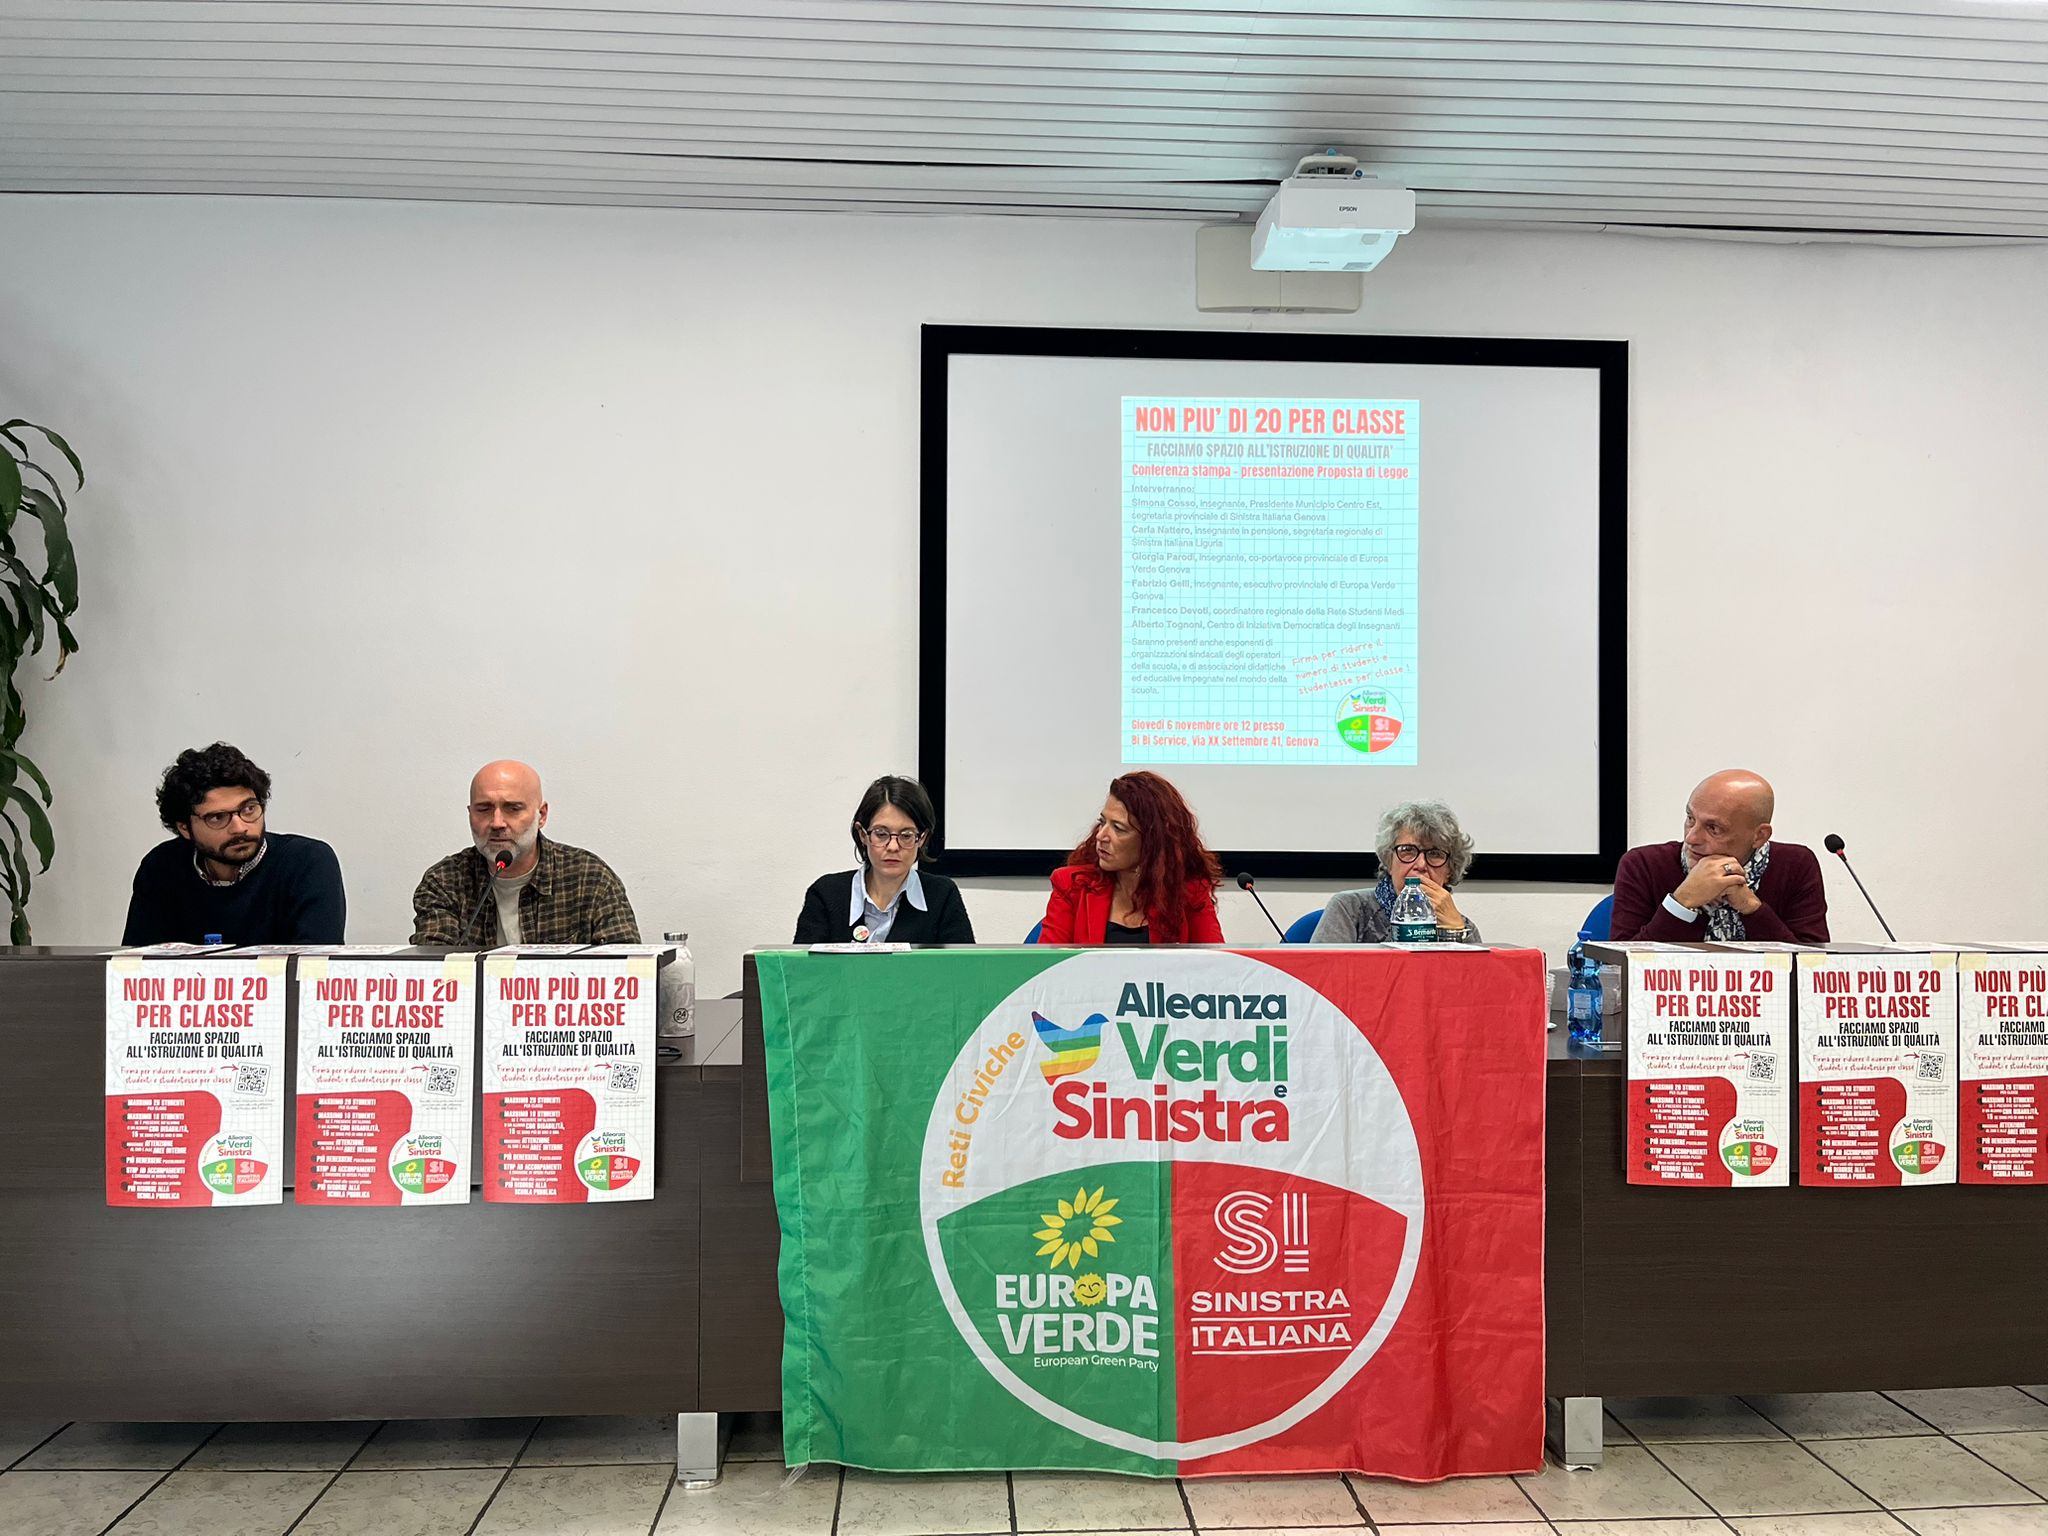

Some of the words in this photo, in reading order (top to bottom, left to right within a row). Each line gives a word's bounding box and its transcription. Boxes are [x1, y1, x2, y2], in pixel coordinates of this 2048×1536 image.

[1136, 407, 1176, 432] NON
[1228, 409, 1248, 432] DI
[1255, 408, 1282, 433] 20
[1289, 409, 1325, 434] PER
[1332, 409, 1405, 435] CLASSE
[1147, 443, 1204, 457] FACCIAMO
[1206, 443, 1244, 458] SPAZIO
[1247, 443, 1330, 458] ALL'ISTRUZIONE
[1333, 444, 1344, 458] DI
[1132, 464, 1190, 476] Conferenza
[1192, 465, 1231, 478] stampa
[1241, 466, 1314, 478] presentazione
[1317, 466, 1363, 479] Proposta
[1366, 466, 1375, 478] di
[1378, 466, 1409, 480] Legge
[1132, 484, 1195, 493] Interverranno:
[1167, 720, 1173, 730] 6
[1175, 720, 1221, 731] novembre
[1223, 722, 1239, 731] ore
[1241, 720, 1251, 731] 12
[1253, 722, 1285, 732] presso
[1208, 736, 1219, 746] XX
[1222, 736, 1268, 746] Settembre
[1286, 737, 1319, 747] Genova
[123, 977, 165, 1001] NON
[173, 972, 206, 1001] PIÙ
[214, 977, 234, 1001] DI
[242, 977, 268, 1001] 20
[316, 977, 357, 1001] NON
[365, 972, 398, 1002] PIÙ
[405, 979, 424, 1002] DI
[432, 978, 458, 1002] 20
[499, 977, 540, 1000] NON
[548, 971, 579, 1000] PIÙ
[587, 977, 606, 999] DI
[614, 976, 639, 1000] 20
[1644, 969, 1681, 992] NON
[1689, 964, 1718, 992] PIÙ
[1725, 970, 1743, 992] DI
[1750, 970, 1773, 993] 20
[1813, 971, 1850, 994] NON
[1858, 966, 1887, 993] PIÙ
[1894, 971, 1911, 993] DI
[1918, 970, 1941, 993] 20
[1975, 970, 2011, 992] NON
[2019, 965, 2046, 992] PIÙ
[1115, 981, 1287, 1020] Alleanza
[1656, 995, 1689, 1016] PER
[1696, 995, 1761, 1017] CLASSE
[1825, 996, 1859, 1018] PER
[1865, 996, 1931, 1018] CLASSE
[1987, 995, 2019, 1017] PER
[136, 1004, 172, 1028] PER
[179, 1004, 254, 1028] CLASSE
[328, 1005, 364, 1028] PER
[371, 1005, 444, 1028] CLASSE
[511, 1003, 547, 1027] PER
[554, 1003, 626, 1027] CLASSE
[150, 1032, 201, 1045] FACCIAMO
[204, 1031, 240, 1044] SPAZIO
[525, 1030, 575, 1043] FACCIAMO
[578, 1030, 612, 1043] SPAZIO
[1669, 1021, 1716, 1033] FACCIAMO
[1719, 1021, 1750, 1033] SPAZIO
[1839, 1022, 1886, 1034] FACCIAMO
[1888, 1022, 1919, 1033] SPAZIO
[2000, 1021, 2045, 1033] FACCIAMO
[341, 1032, 392, 1045] FACCIAMO
[395, 1032, 430, 1045] SPAZIO
[502, 1043, 577, 1056] ALL'ISTRUZIONE
[581, 1044, 592, 1056] DI
[595, 1040, 636, 1057] QUALITÀ
[1647, 1033, 1720, 1046] ALL'ISTRUZIONE
[1722, 1034, 1732, 1046] DI
[1734, 1031, 1771, 1047] QUALITÀ
[1818, 1035, 1889, 1047] ALL'ISTRUZIONE
[1892, 1035, 1901, 1047] DI
[1904, 1031, 1940, 1048] QUALITÀ
[126, 1045, 204, 1059] ALL'ISTRUZIONE
[207, 1045, 218, 1058] DI
[221, 1042, 263, 1060] QUALITÀ
[318, 1045, 395, 1058] ALL'ISTRUZIONE
[398, 1045, 410, 1058] DI
[412, 1043, 454, 1060] QUALITÀ
[1116, 1021, 1289, 1083] Verdi
[956, 1030, 1026, 1126] Civiche
[1273, 1084, 1288, 1098] e
[1052, 1080, 1290, 1143] Sinistra
[942, 1130, 971, 1189] Reti
[1190, 1288, 1350, 1313] SINISTRA
[998, 1312, 1160, 1358] VERDE
[1192, 1322, 1352, 1347] ITALIANA
[1034, 1355, 1089, 1368] European
[1091, 1355, 1126, 1367] Green
[1128, 1359, 1159, 1373] Party
